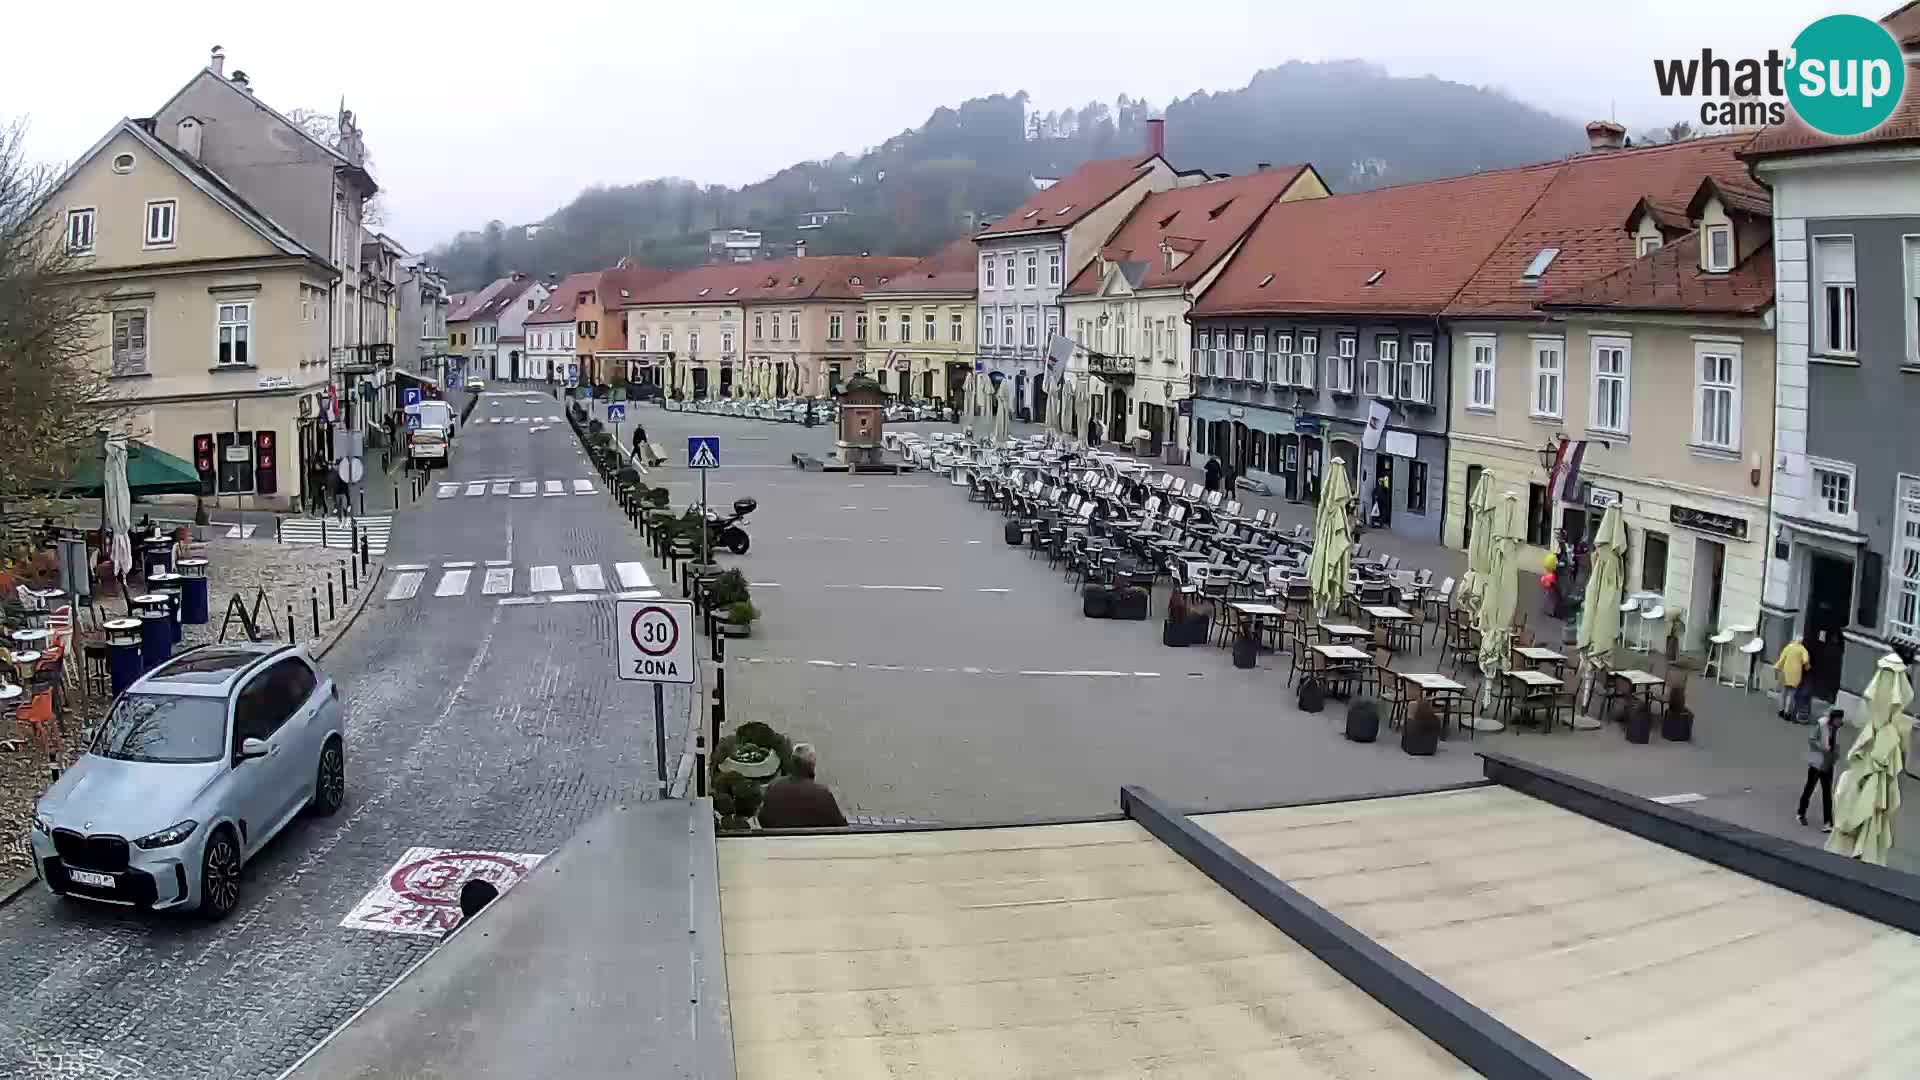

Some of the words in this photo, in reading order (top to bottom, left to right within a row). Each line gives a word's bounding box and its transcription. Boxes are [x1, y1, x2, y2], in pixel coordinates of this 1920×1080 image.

[408, 391, 416, 403] P
[643, 622, 667, 643] 30
[634, 660, 678, 676] ZONA
